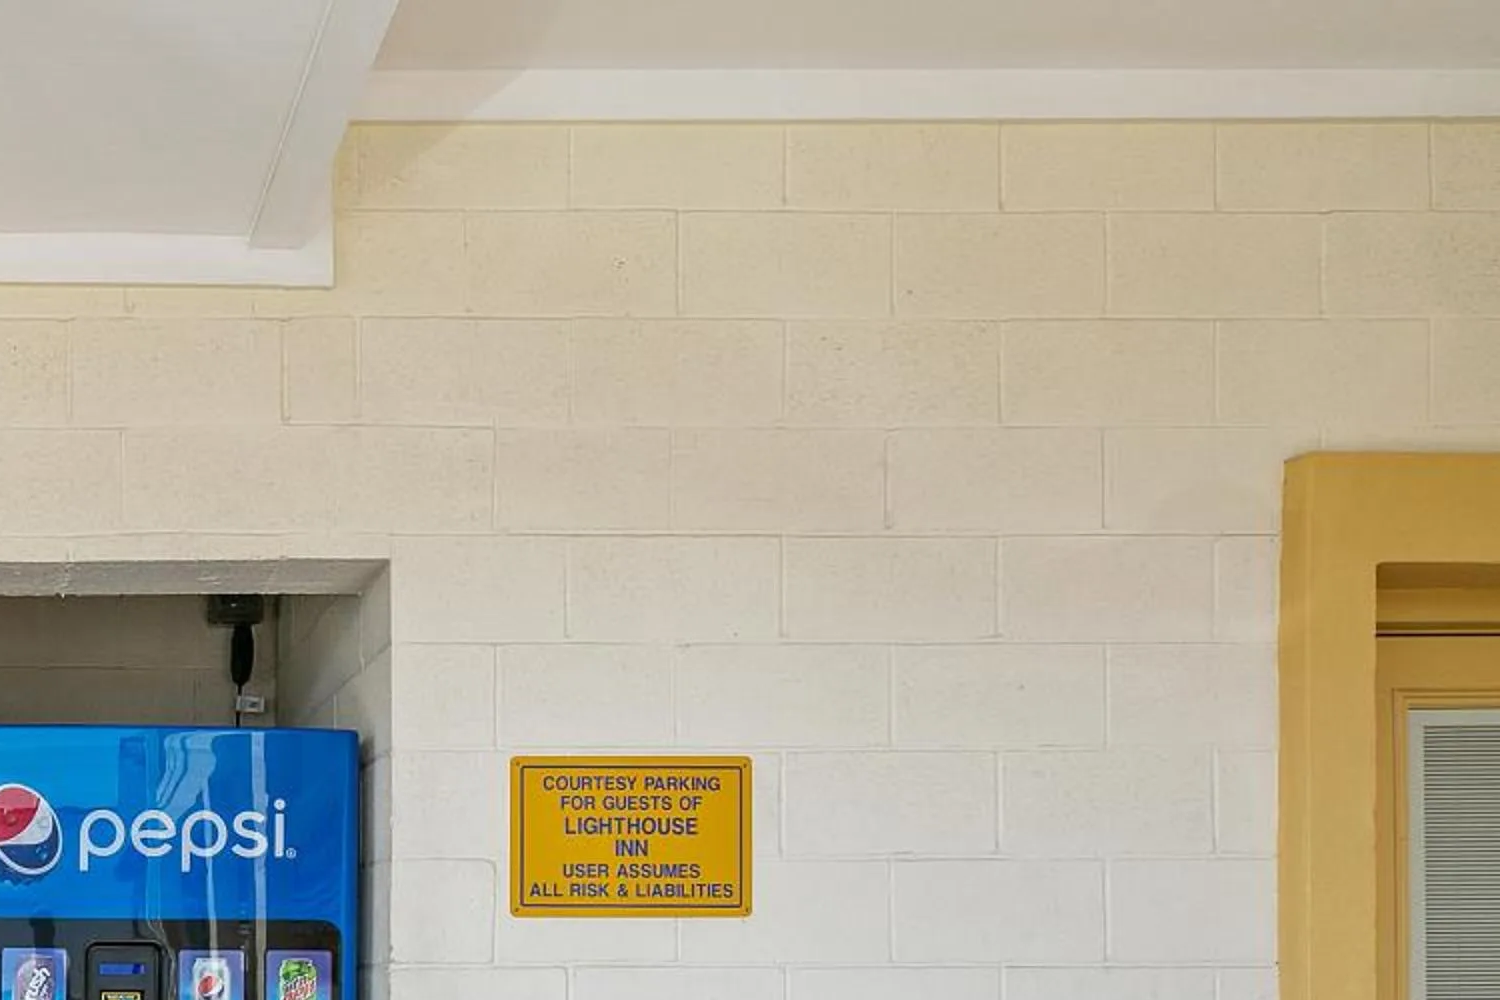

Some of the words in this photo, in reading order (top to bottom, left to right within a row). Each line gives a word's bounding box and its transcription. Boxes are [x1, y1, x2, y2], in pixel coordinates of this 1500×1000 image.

[543, 776, 637, 791] COURTESY
[644, 776, 721, 791] PARKING
[561, 796, 595, 810] FOR
[602, 796, 672, 810] GUESTS
[679, 796, 702, 810] OF
[565, 818, 698, 835] LIGHTHOUSE
[79, 799, 287, 873] pepsi
[615, 840, 648, 856] INN
[563, 864, 609, 878] USER
[617, 864, 700, 878] ASSUMES
[530, 884, 562, 897] ALL
[570, 884, 609, 897] RISK
[617, 884, 628, 897] &
[636, 884, 733, 897] LIABILITIES
